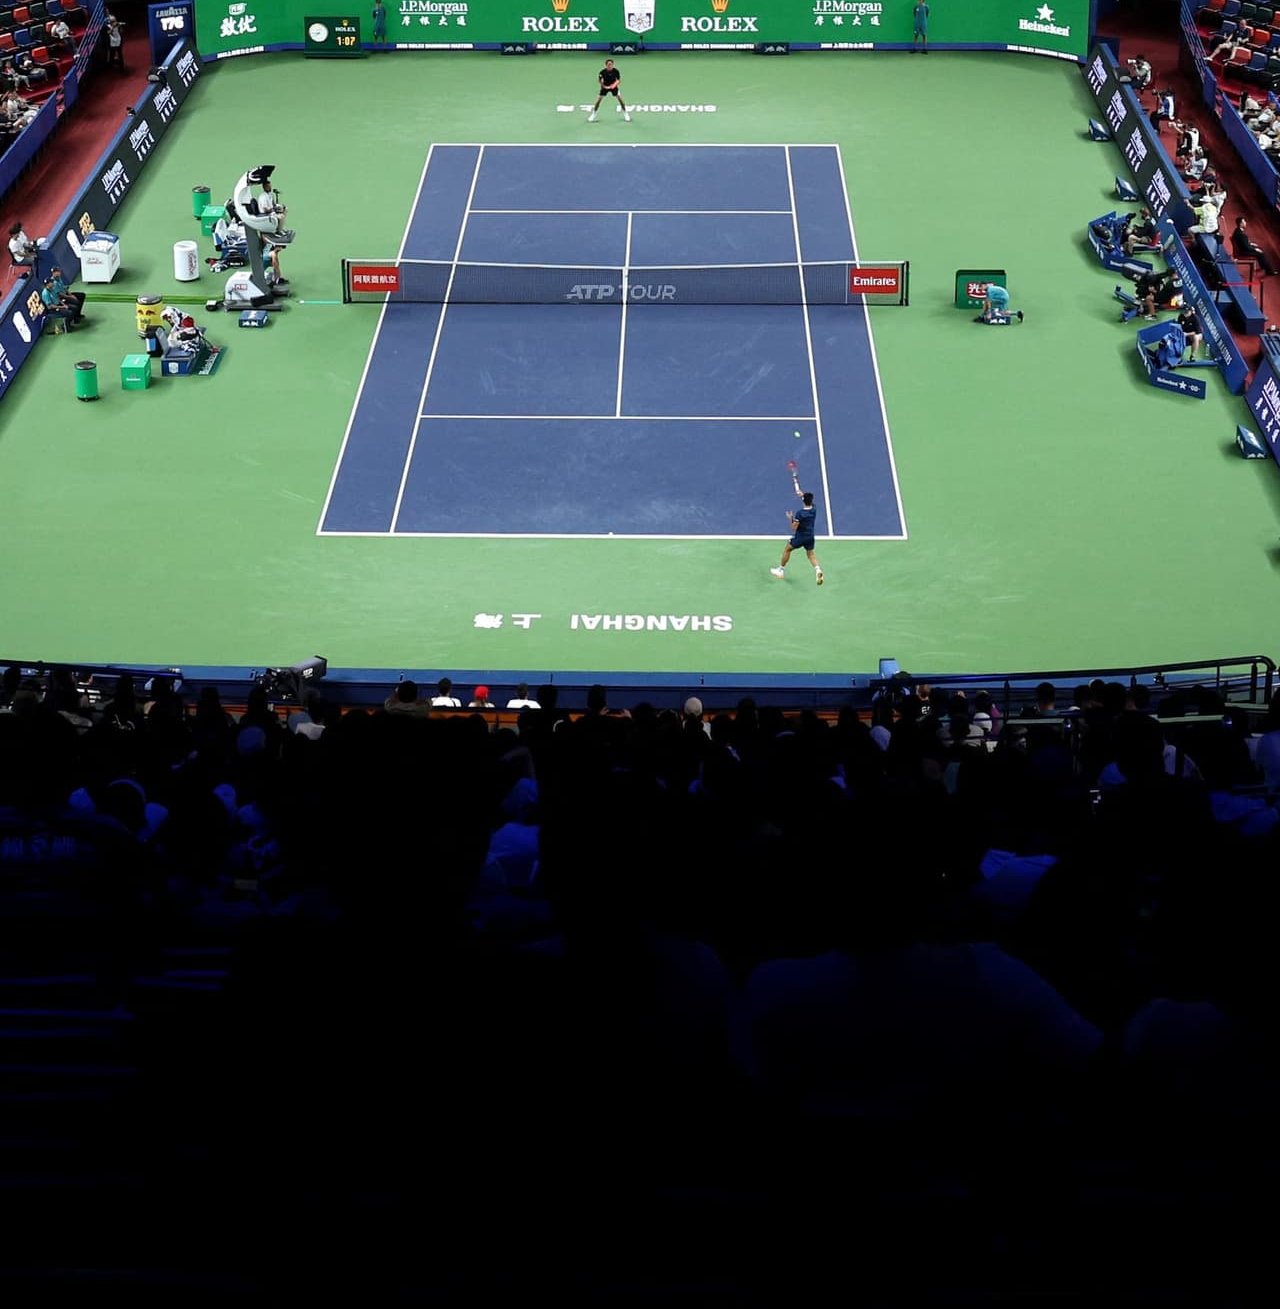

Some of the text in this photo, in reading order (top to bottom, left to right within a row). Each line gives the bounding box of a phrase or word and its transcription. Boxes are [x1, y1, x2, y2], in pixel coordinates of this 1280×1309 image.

[399, 0, 468, 15] J.P.Morgan
[812, 0, 882, 15] J.P.Morgan
[522, 17, 599, 32] ROLEX
[681, 17, 759, 32] ROLEX
[1019, 19, 1069, 37] Heineken
[337, 36, 356, 46] 1:07
[853, 276, 896, 286] Emirates
[565, 284, 615, 300] ATP
[570, 614, 732, 631] SHANGHAI
